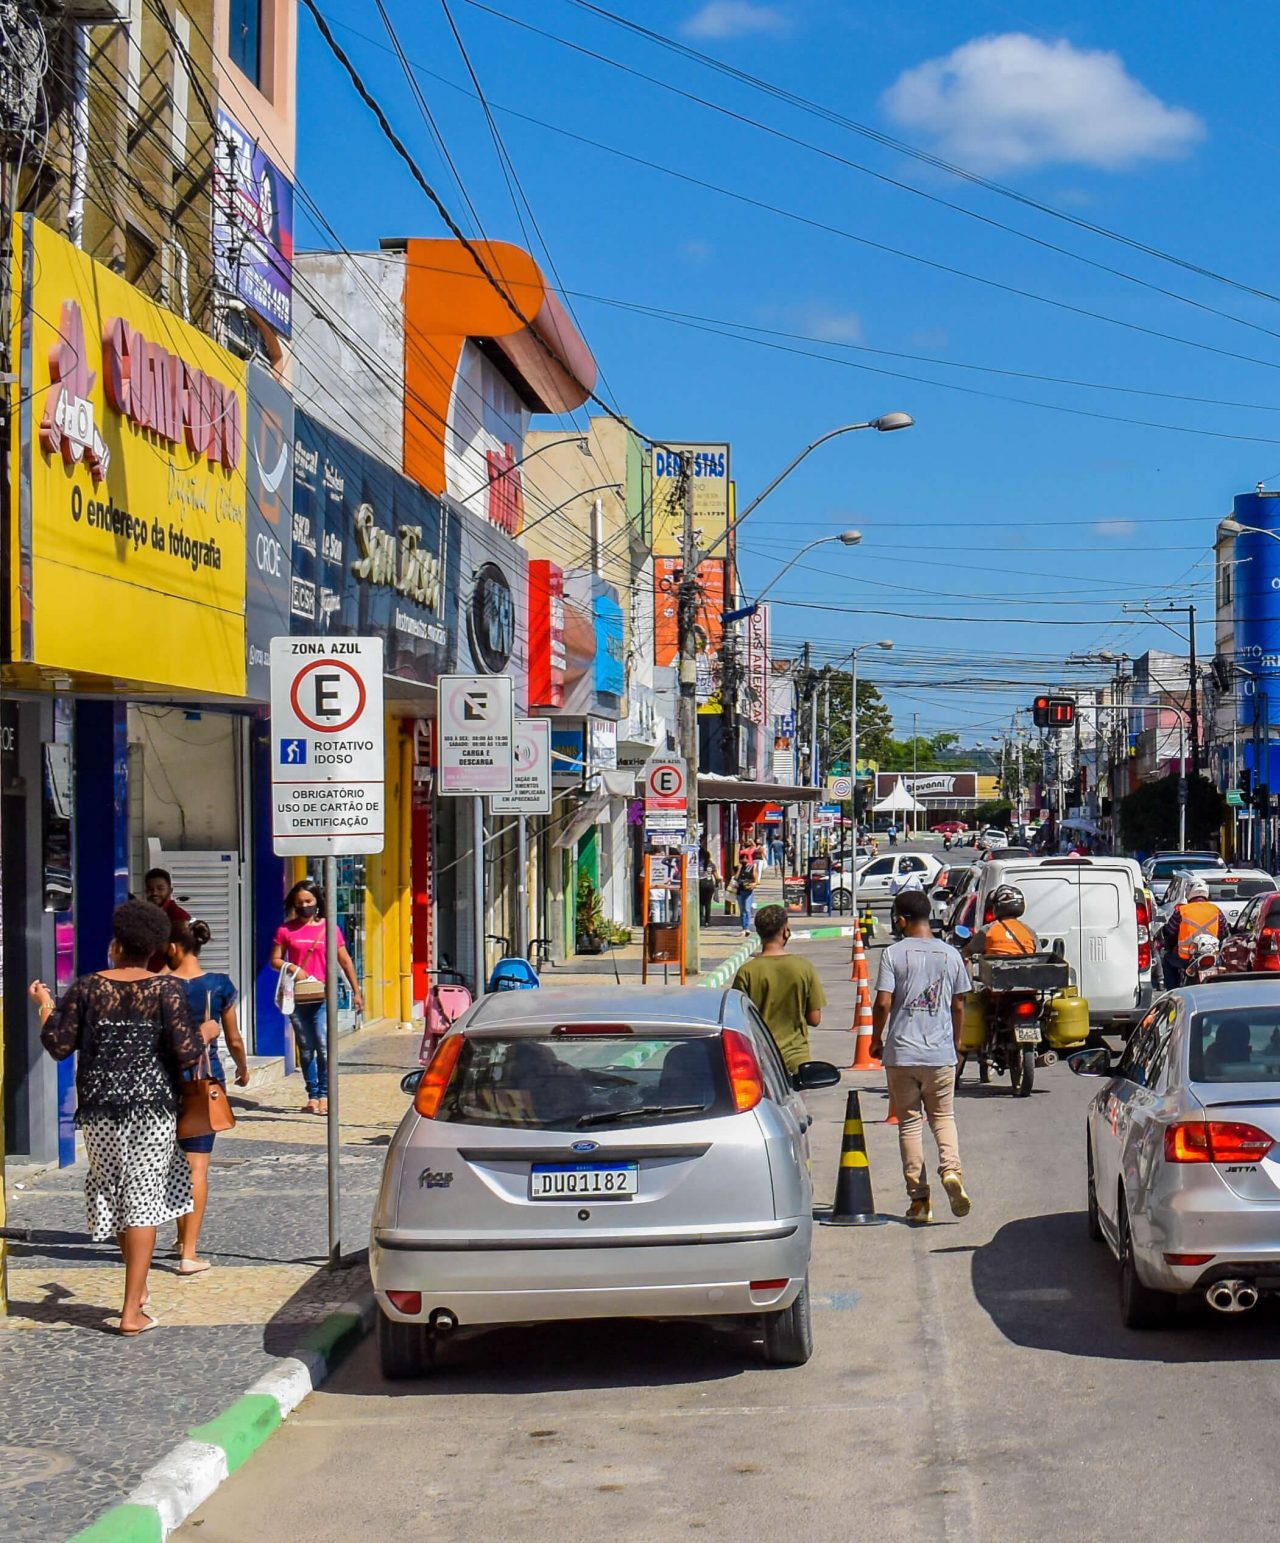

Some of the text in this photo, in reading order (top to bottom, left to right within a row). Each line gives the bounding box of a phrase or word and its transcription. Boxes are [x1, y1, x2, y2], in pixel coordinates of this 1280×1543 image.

[656, 451, 725, 478] DENSTAS
[71, 485, 221, 572] O endereço da fotografia
[256, 532, 281, 578] CROE
[292, 643, 362, 655] ZONA AZUL
[315, 674, 341, 717] E
[314, 740, 373, 752] ROTATIVO
[462, 749, 486, 757] CARGA
[314, 754, 353, 765] IDOSO
[459, 758, 494, 766] DESCARGA
[661, 772, 672, 791] E
[906, 780, 945, 793] giovanni
[292, 788, 365, 800] OBRIGATÓRIO
[278, 801, 379, 813] USO DE CARTÃO DE
[292, 815, 369, 829] DENTIFICAÇÃO
[574, 1141, 596, 1152] Ford
[1225, 1165, 1258, 1173] JETTA
